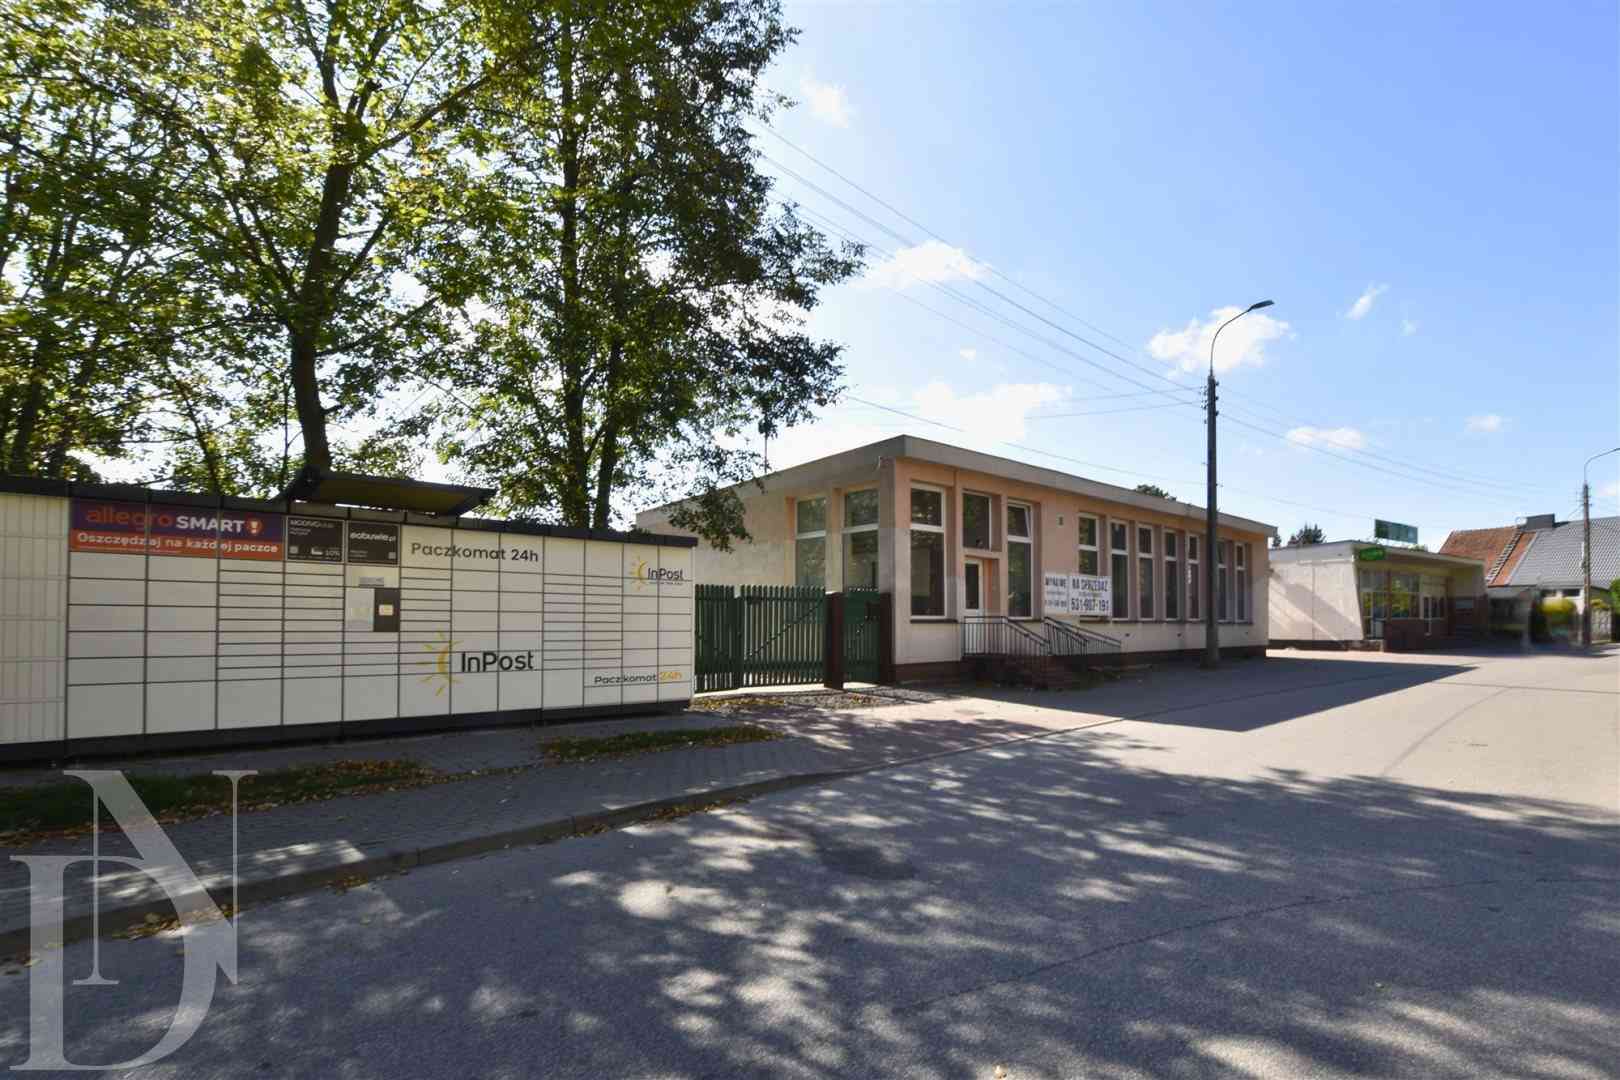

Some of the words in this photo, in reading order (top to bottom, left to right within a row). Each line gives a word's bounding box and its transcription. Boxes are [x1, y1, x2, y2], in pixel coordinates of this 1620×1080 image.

[85, 505, 174, 532] allegro
[166, 539, 183, 548] na
[235, 543, 279, 553] paczce
[411, 542, 506, 560] Paczkomat
[511, 548, 538, 562] 24h
[648, 567, 683, 581] InPost
[461, 650, 534, 673] InPost
[594, 674, 657, 684] Paczkomat
